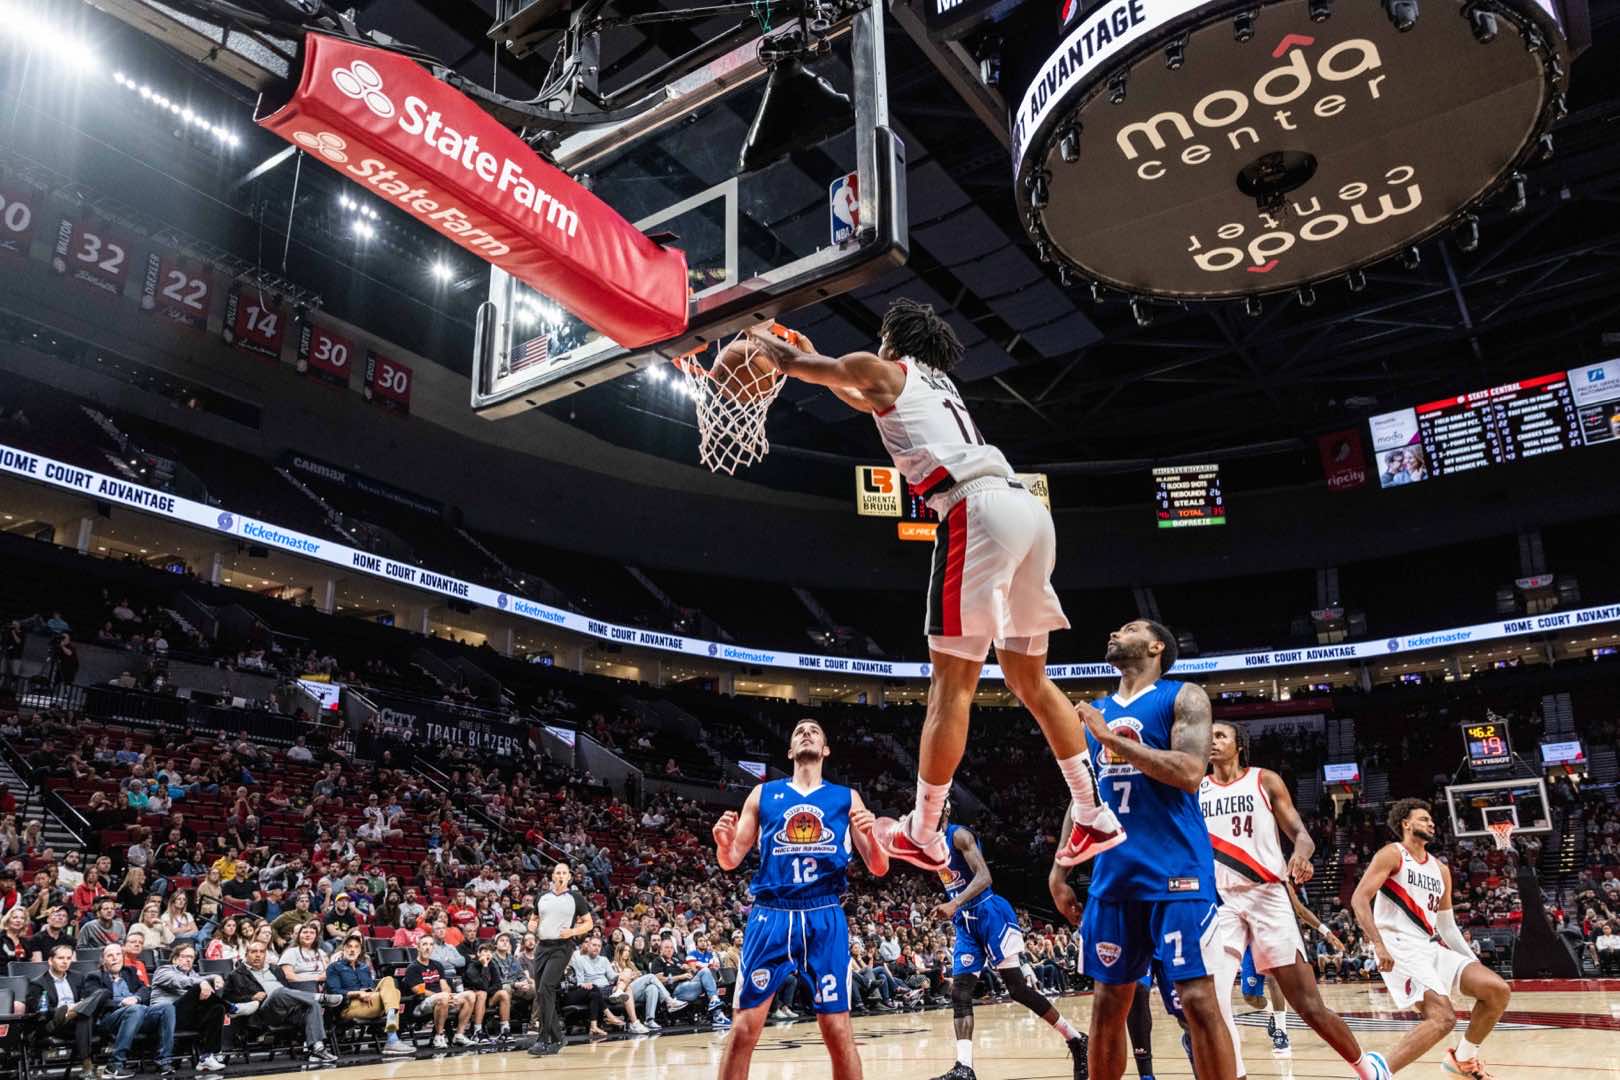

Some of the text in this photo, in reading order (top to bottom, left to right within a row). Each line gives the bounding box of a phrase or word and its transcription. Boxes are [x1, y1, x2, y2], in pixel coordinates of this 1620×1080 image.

[1030, 1, 1147, 122] ADVANTAGE
[1116, 38, 1382, 160] moda
[1137, 75, 1386, 180] center
[0, 194, 31, 232] 0
[1188, 165, 1415, 252] center
[56, 220, 72, 255] WALTON
[835, 226, 852, 242] NBA
[1193, 184, 1424, 272] moda
[77, 232, 124, 274] 32
[163, 270, 207, 309] 22
[246, 306, 277, 338] 14
[314, 337, 347, 367] 30
[378, 365, 407, 394] 30
[1467, 390, 1489, 401] STATS
[1489, 382, 1522, 396] CENTRAL
[45, 463, 94, 489] COURT
[98, 479, 175, 513] ADVANTAGE
[1171, 490, 1206, 498] REBOUNDS
[863, 503, 896, 511] BRUUN
[1174, 499, 1205, 507] STEALS
[243, 521, 320, 553] ticketmaster
[353, 552, 469, 597] HOME COURT ADVANTAGE
[514, 601, 567, 625] ticketmaster
[1504, 620, 1533, 634] HOME
[1537, 614, 1571, 629] COURT
[588, 620, 683, 651] HOME COURT ADVANTAGE
[1407, 630, 1472, 648] ticketmaster
[724, 648, 775, 664] ticketmaster
[799, 655, 893, 674] HOME COURT ADVANTAGE
[1245, 646, 1357, 666] HOME COURT ADVANTAGE
[1046, 665, 1117, 677] OURT ADVANTAGE
[426, 723, 463, 746] TRAIL
[468, 730, 519, 752] BLAZERS
[1468, 726, 1495, 739] 46.2
[1482, 736, 1503, 755] 19
[1112, 781, 1132, 814] 7
[1201, 795, 1254, 817] BLAZERS
[1232, 815, 1253, 838] 34
[791, 857, 819, 885] 12
[1407, 869, 1442, 894] BLAZERS
[1164, 930, 1186, 967] 7
